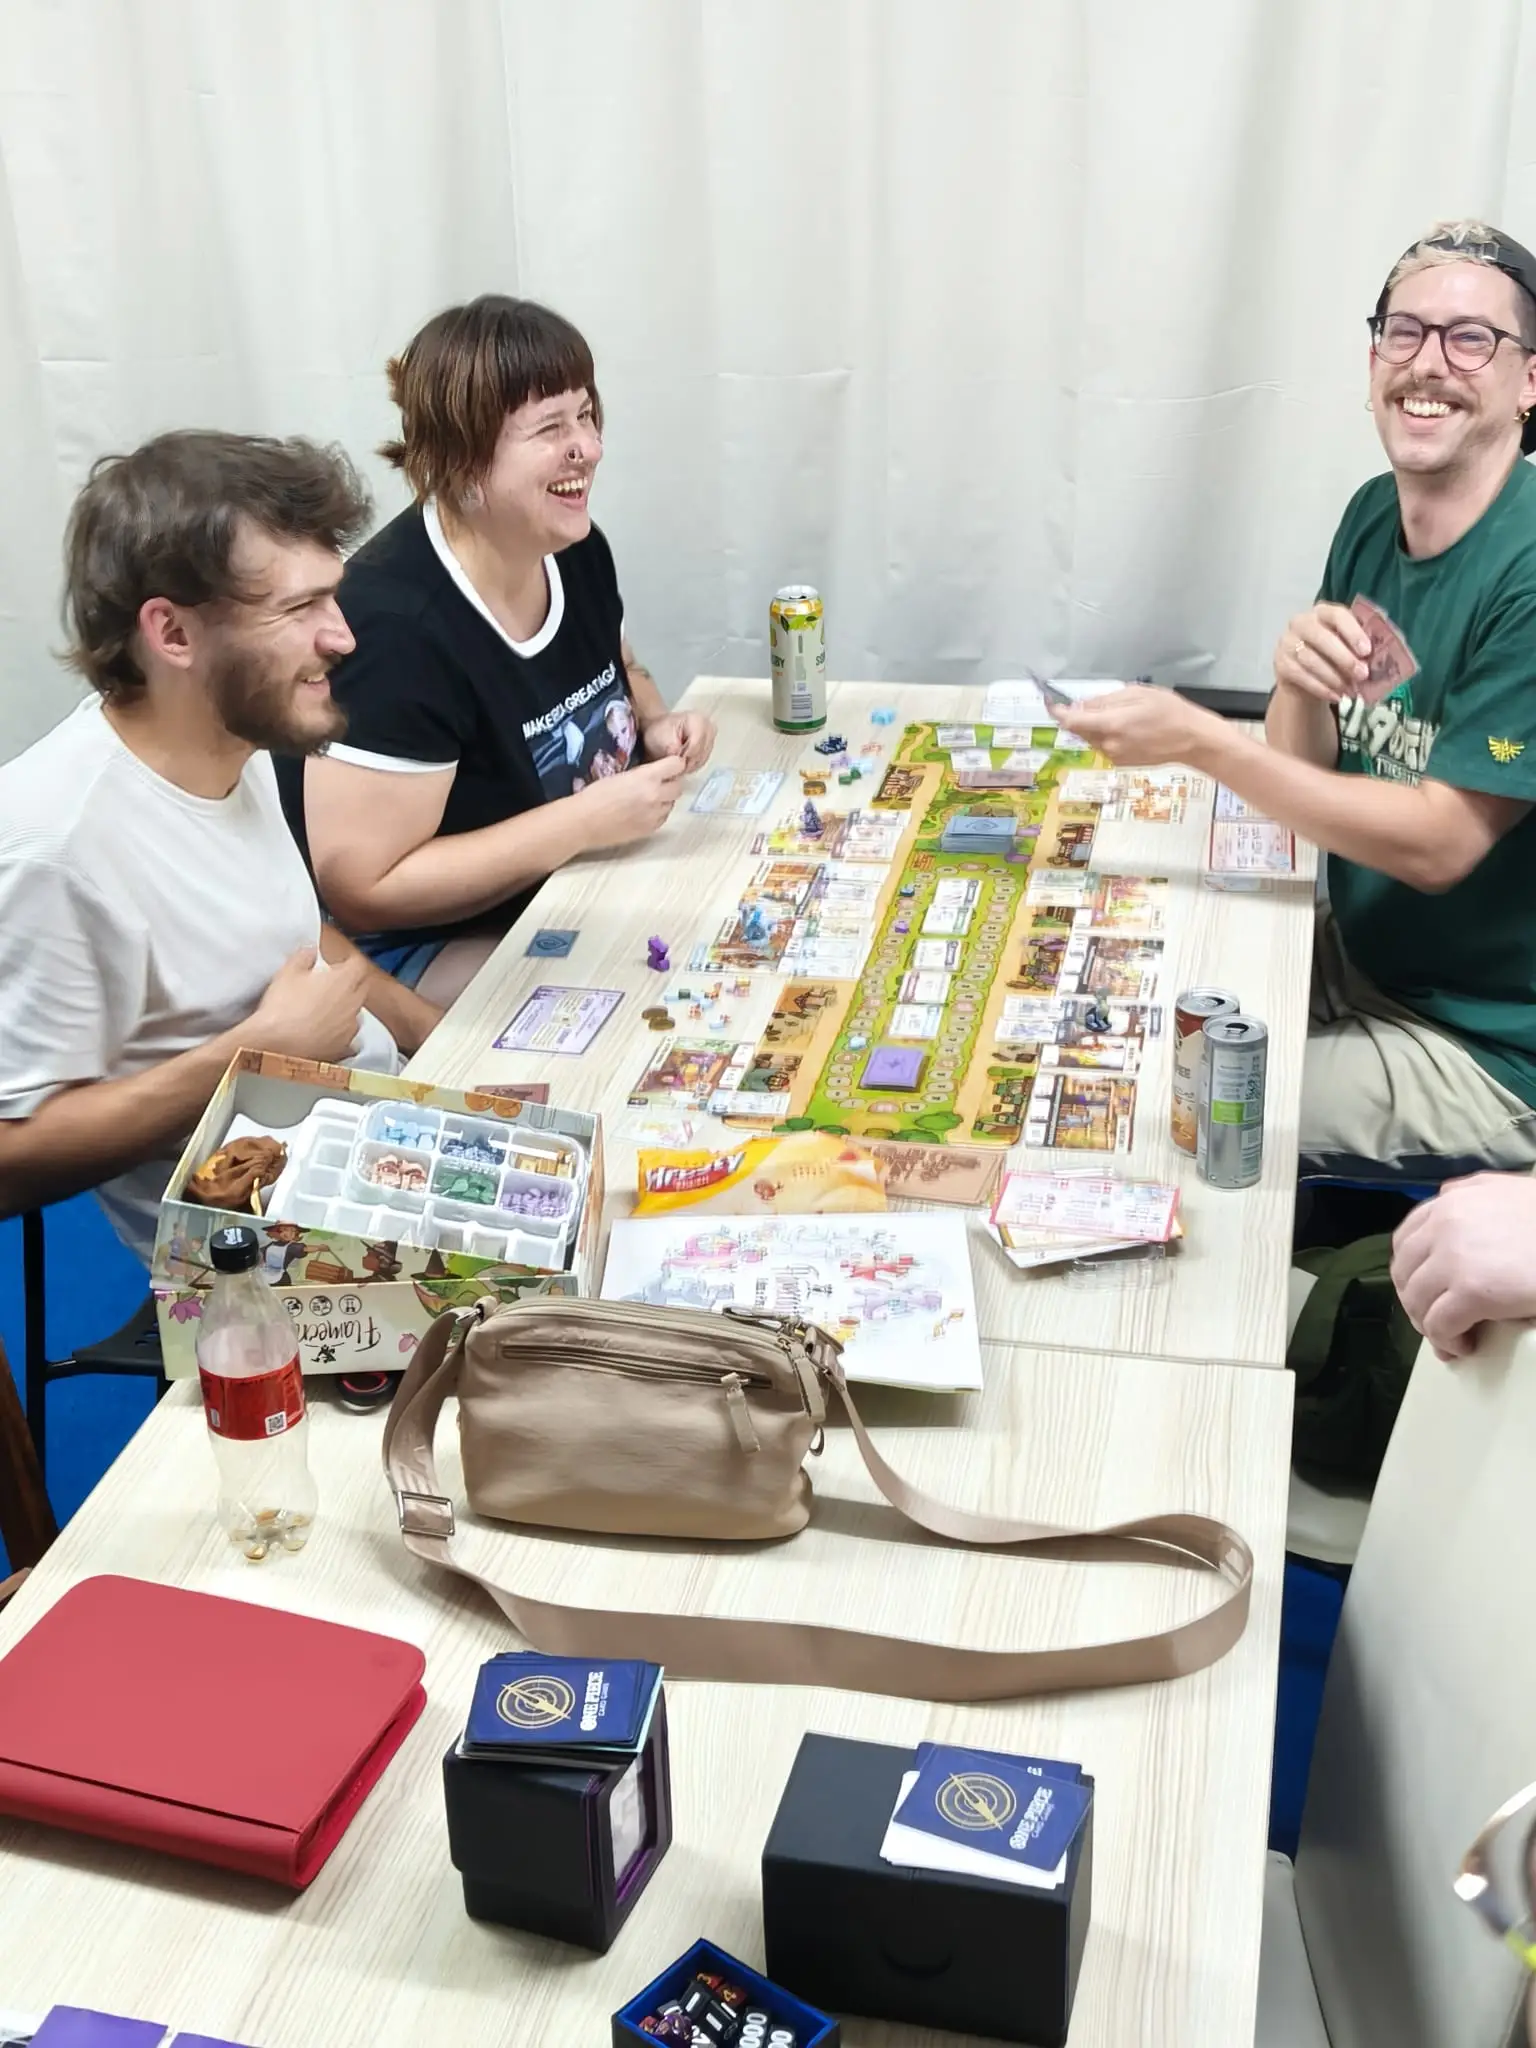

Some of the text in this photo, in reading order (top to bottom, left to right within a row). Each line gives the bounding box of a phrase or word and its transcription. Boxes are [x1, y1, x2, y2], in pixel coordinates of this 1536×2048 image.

[564, 678, 600, 713] GREAT
[295, 1316, 381, 1353] Flamecr
[580, 1671, 604, 1731] ONE PIECE
